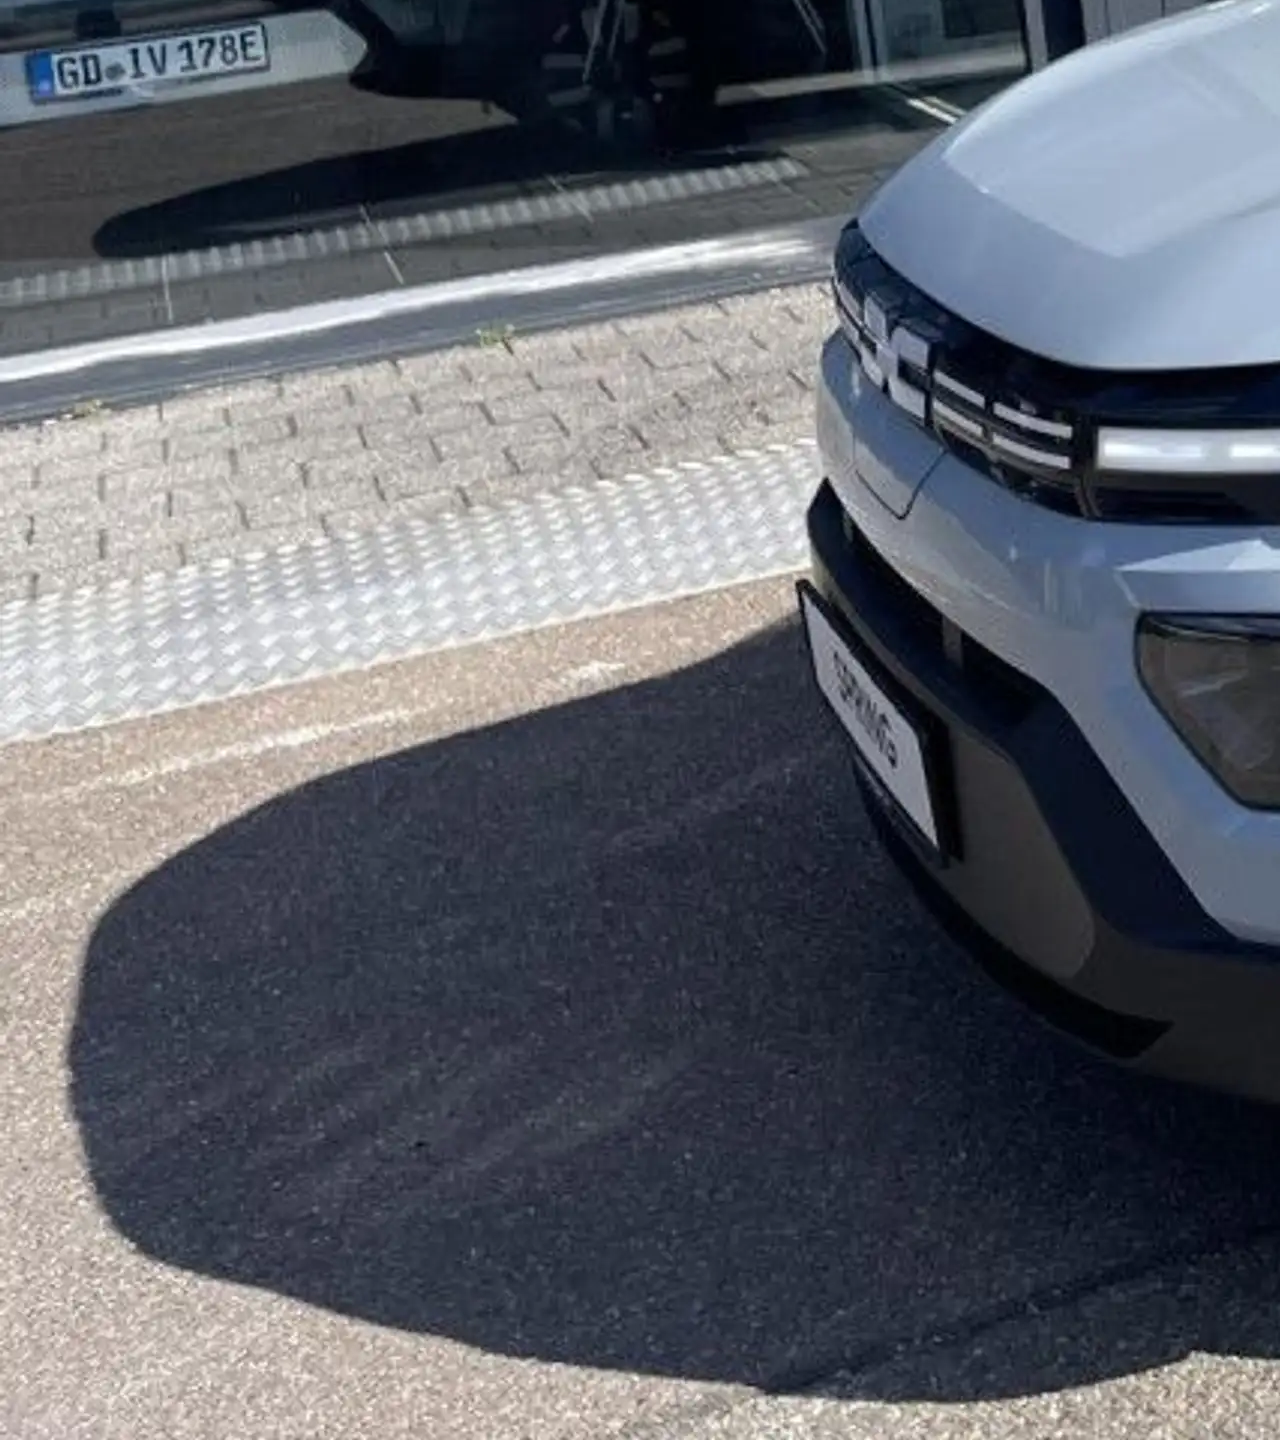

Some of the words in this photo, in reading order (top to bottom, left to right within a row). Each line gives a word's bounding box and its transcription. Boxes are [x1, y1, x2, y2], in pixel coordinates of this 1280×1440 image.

[56, 52, 103, 89] GD
[127, 44, 168, 79] IV
[176, 30, 262, 73] 178E
